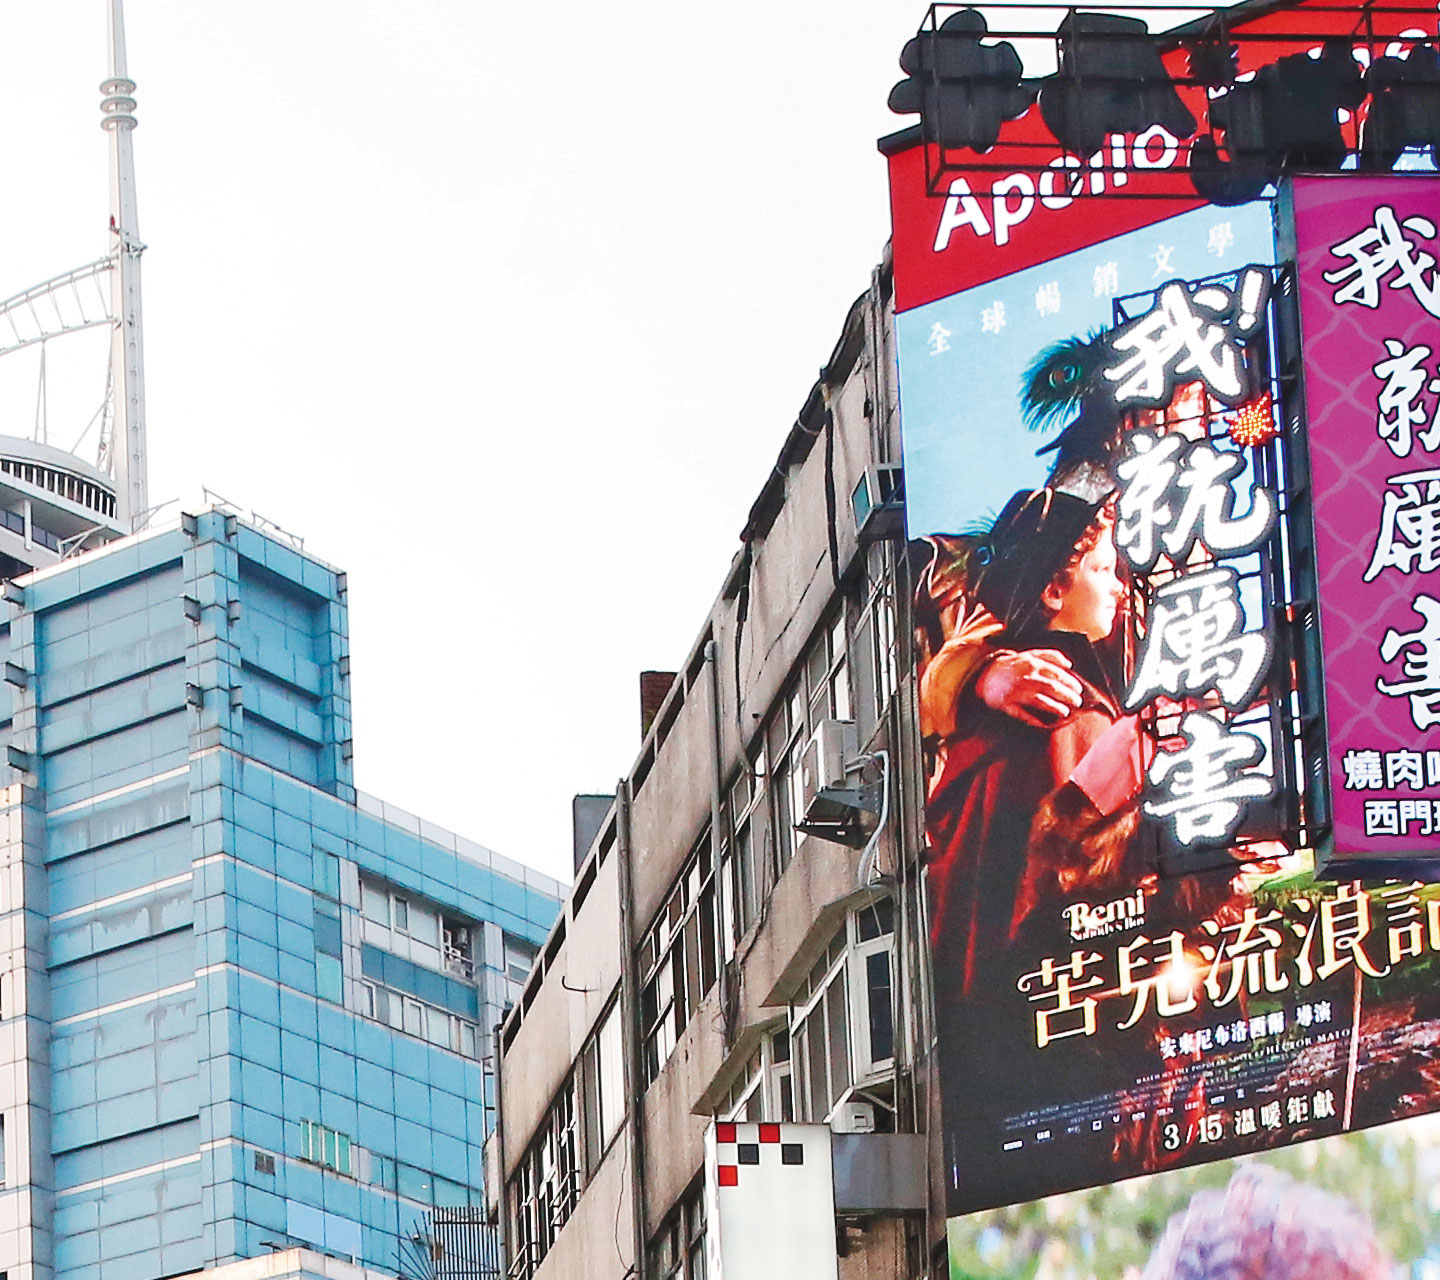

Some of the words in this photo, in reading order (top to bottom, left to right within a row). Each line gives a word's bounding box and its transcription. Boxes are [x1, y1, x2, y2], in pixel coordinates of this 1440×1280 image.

[933, 126, 1179, 252] Apollo
[926, 222, 1235, 354] 全球暢銷文學
